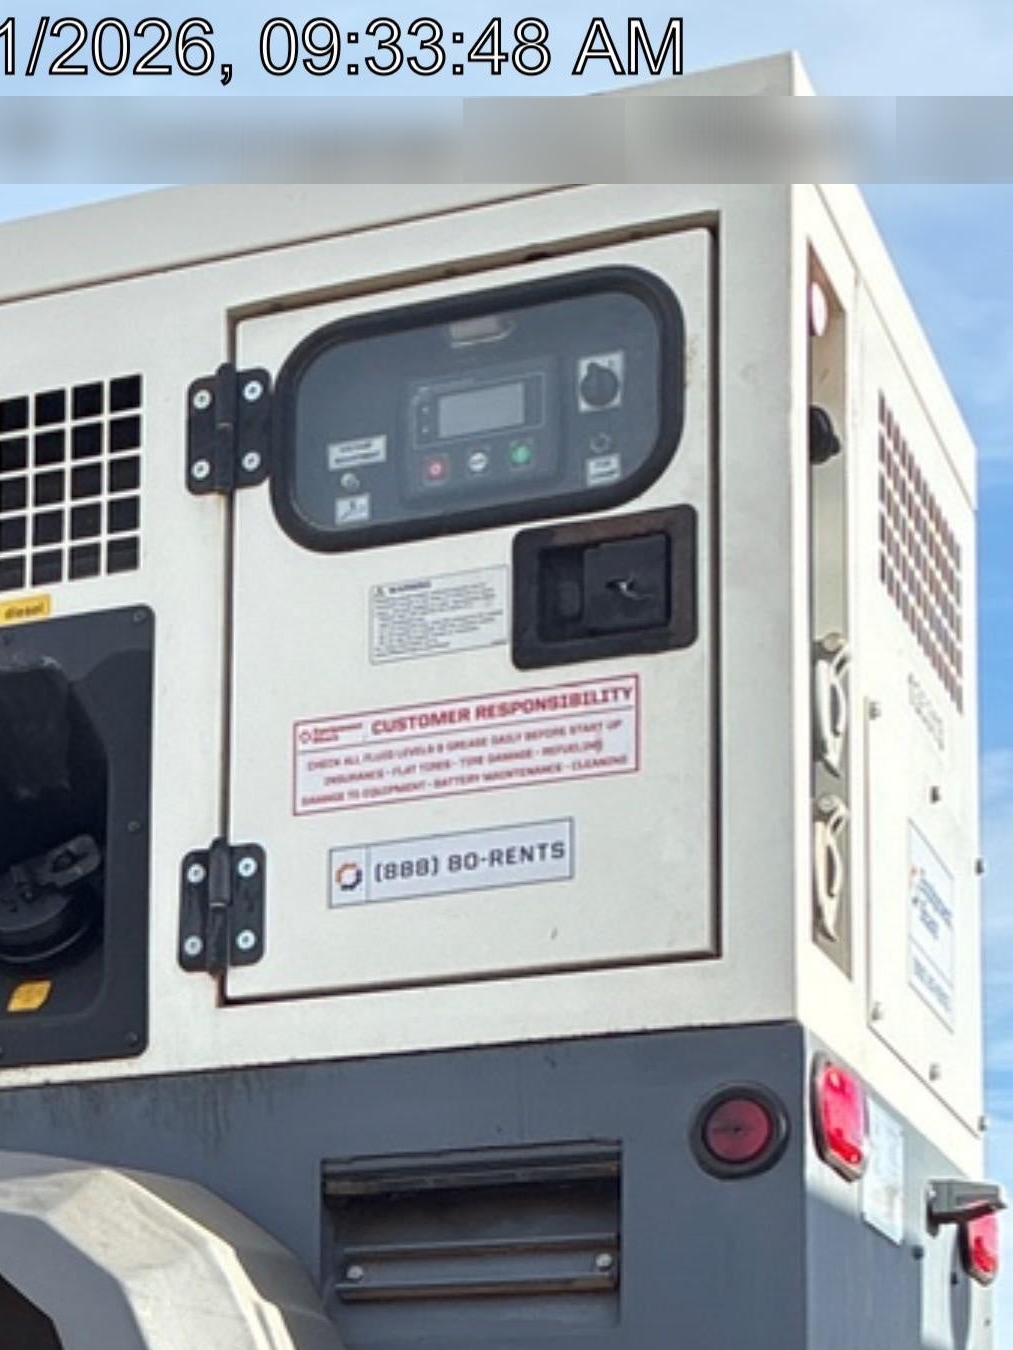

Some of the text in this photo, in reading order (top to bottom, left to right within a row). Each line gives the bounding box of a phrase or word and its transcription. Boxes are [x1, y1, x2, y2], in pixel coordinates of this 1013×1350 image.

[371, 687, 632, 735] CUSTOMER RESPONSIBILITY
[374, 840, 565, 883] (888) 80-RENTS
